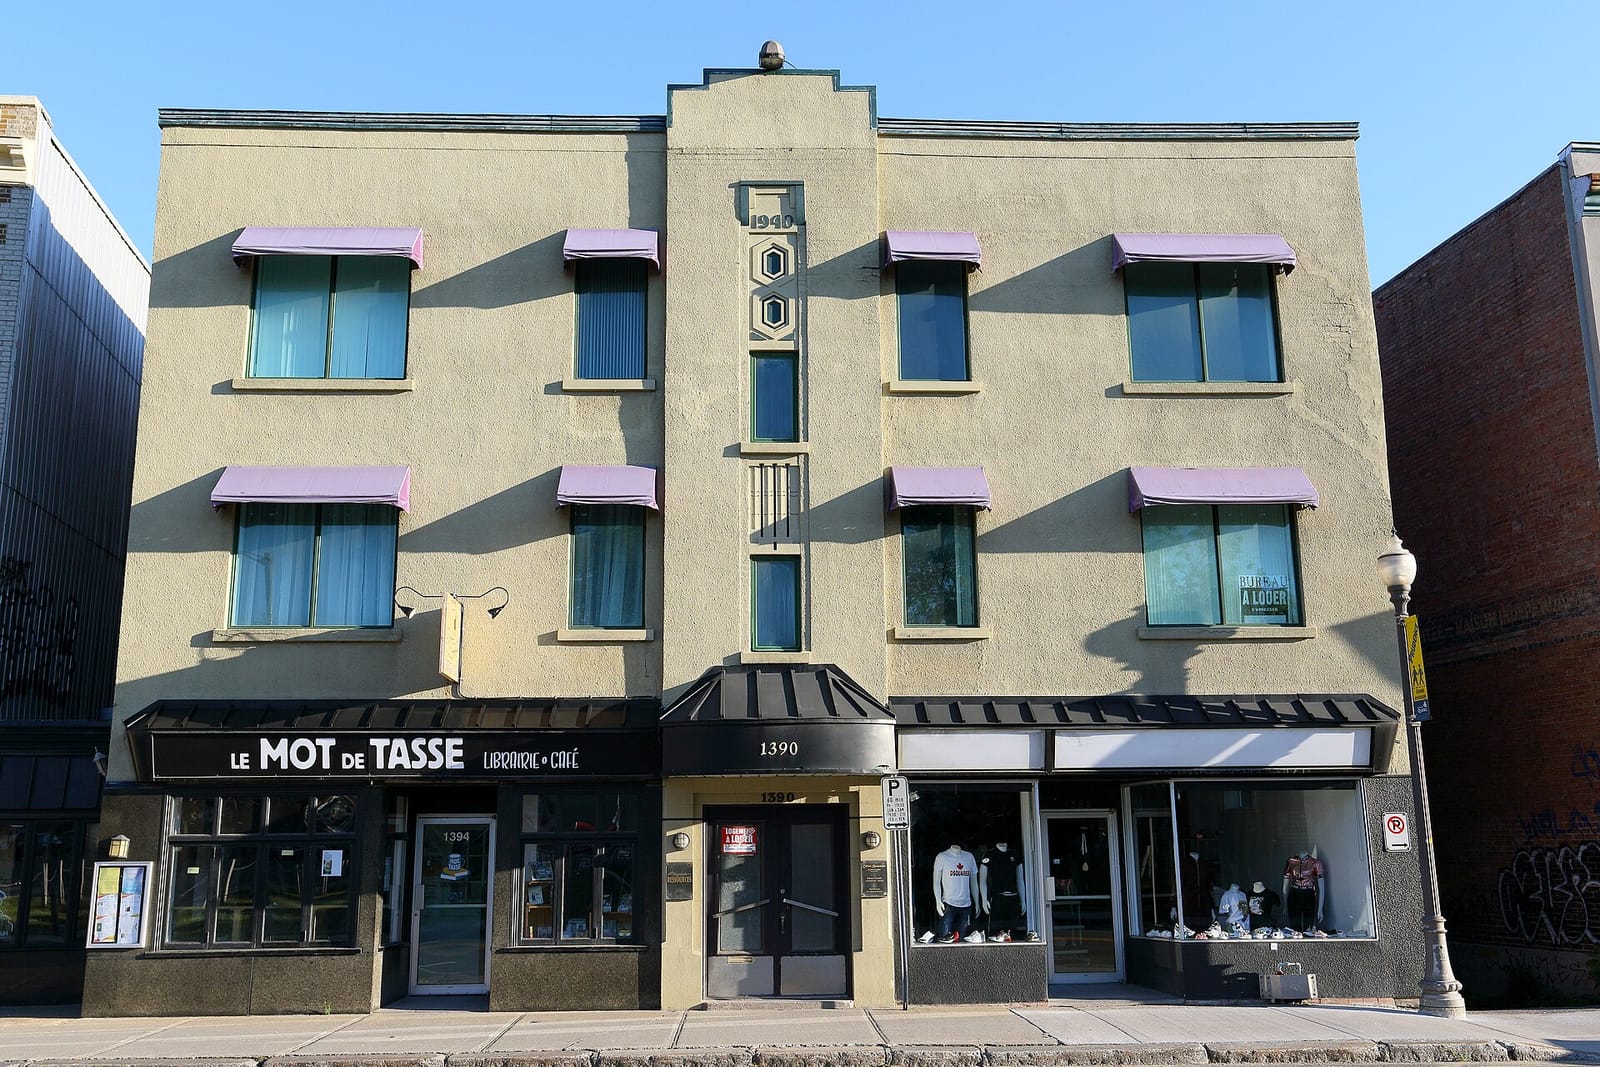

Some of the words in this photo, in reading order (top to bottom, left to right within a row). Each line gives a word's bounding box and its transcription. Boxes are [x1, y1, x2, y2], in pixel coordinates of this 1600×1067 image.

[751, 214, 794, 229] 1940
[1239, 575, 1288, 587] BUREAU
[1242, 591, 1250, 605] A
[1252, 590, 1287, 605] LOUER
[230, 753, 250, 769] LE
[260, 738, 336, 770] MOT
[341, 753, 365, 770] DE
[369, 738, 465, 770] TASSE
[483, 751, 540, 769] LIBRAIRIE
[550, 747, 580, 769] CAFÉ
[760, 741, 798, 756] 1390
[888, 780, 900, 796] P
[761, 792, 794, 802] 1390
[443, 831, 470, 842] 1394
